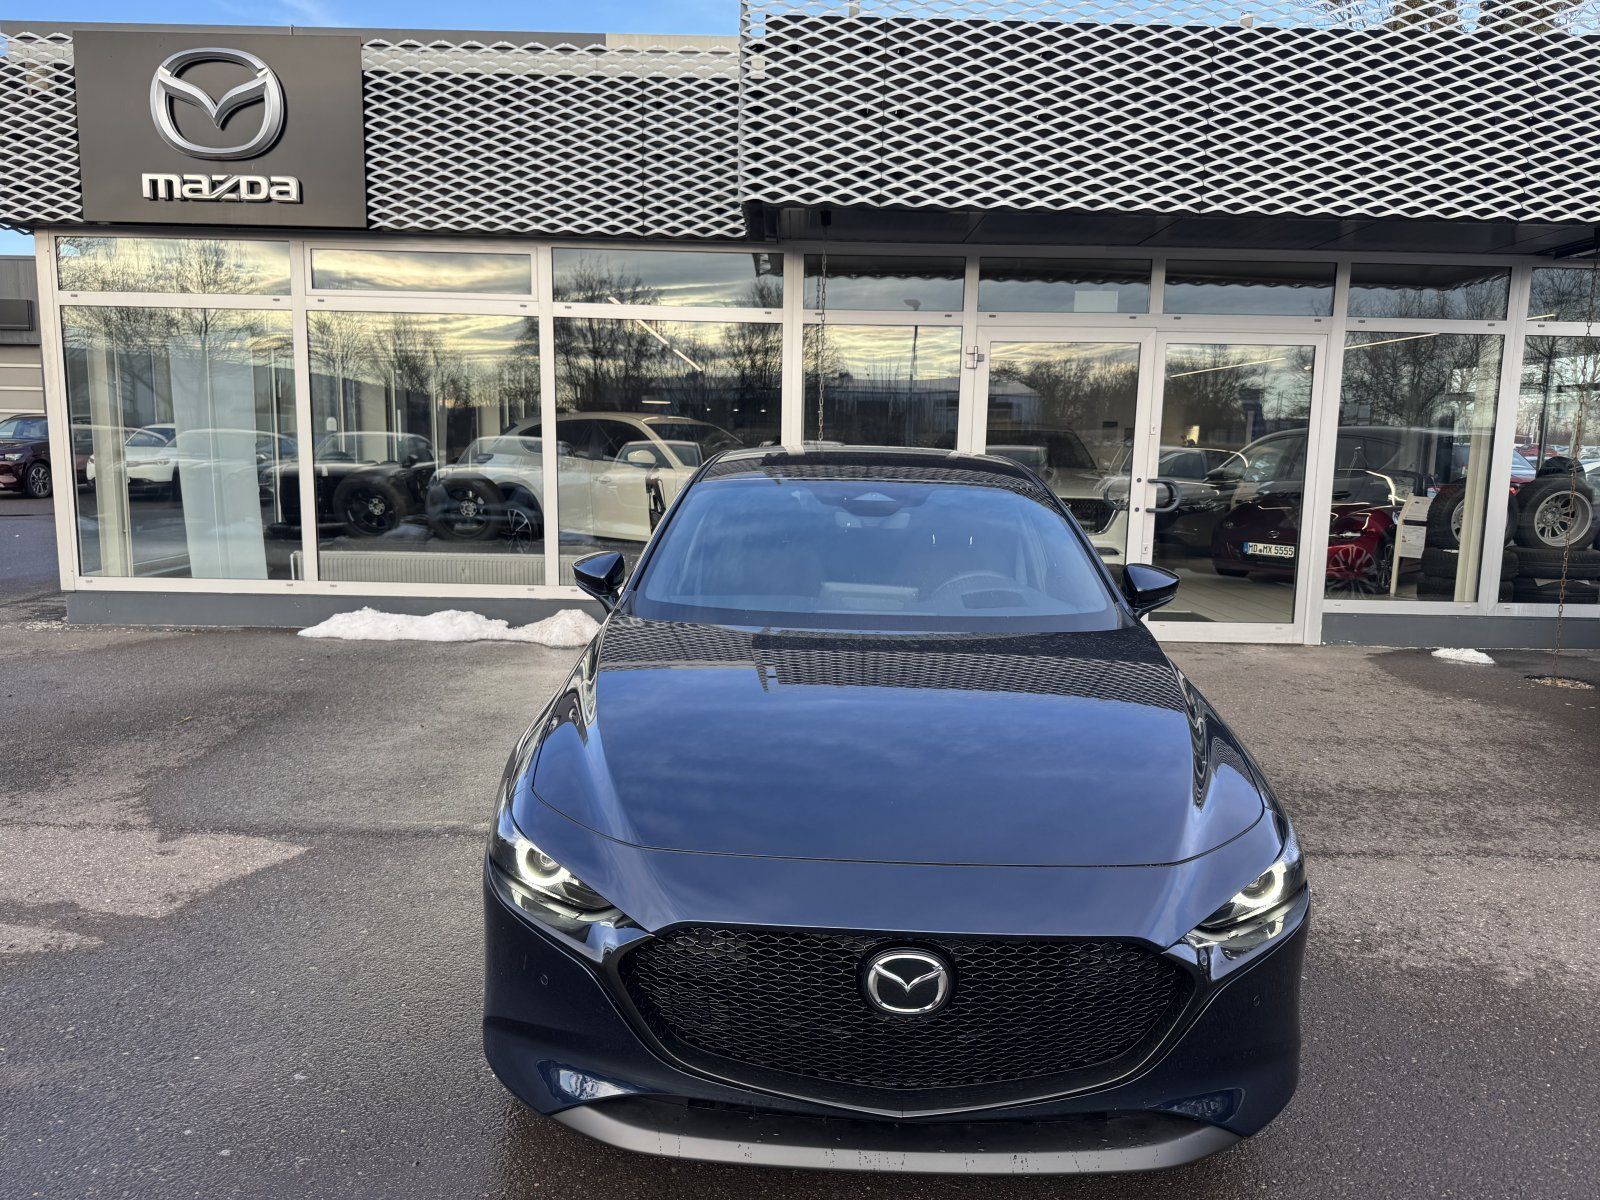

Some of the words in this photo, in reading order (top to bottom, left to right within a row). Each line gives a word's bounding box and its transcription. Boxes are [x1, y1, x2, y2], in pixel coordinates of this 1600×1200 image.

[1248, 543, 1258, 553] MD
[1263, 545, 1273, 554] MX
[1274, 546, 1294, 556] 5555
